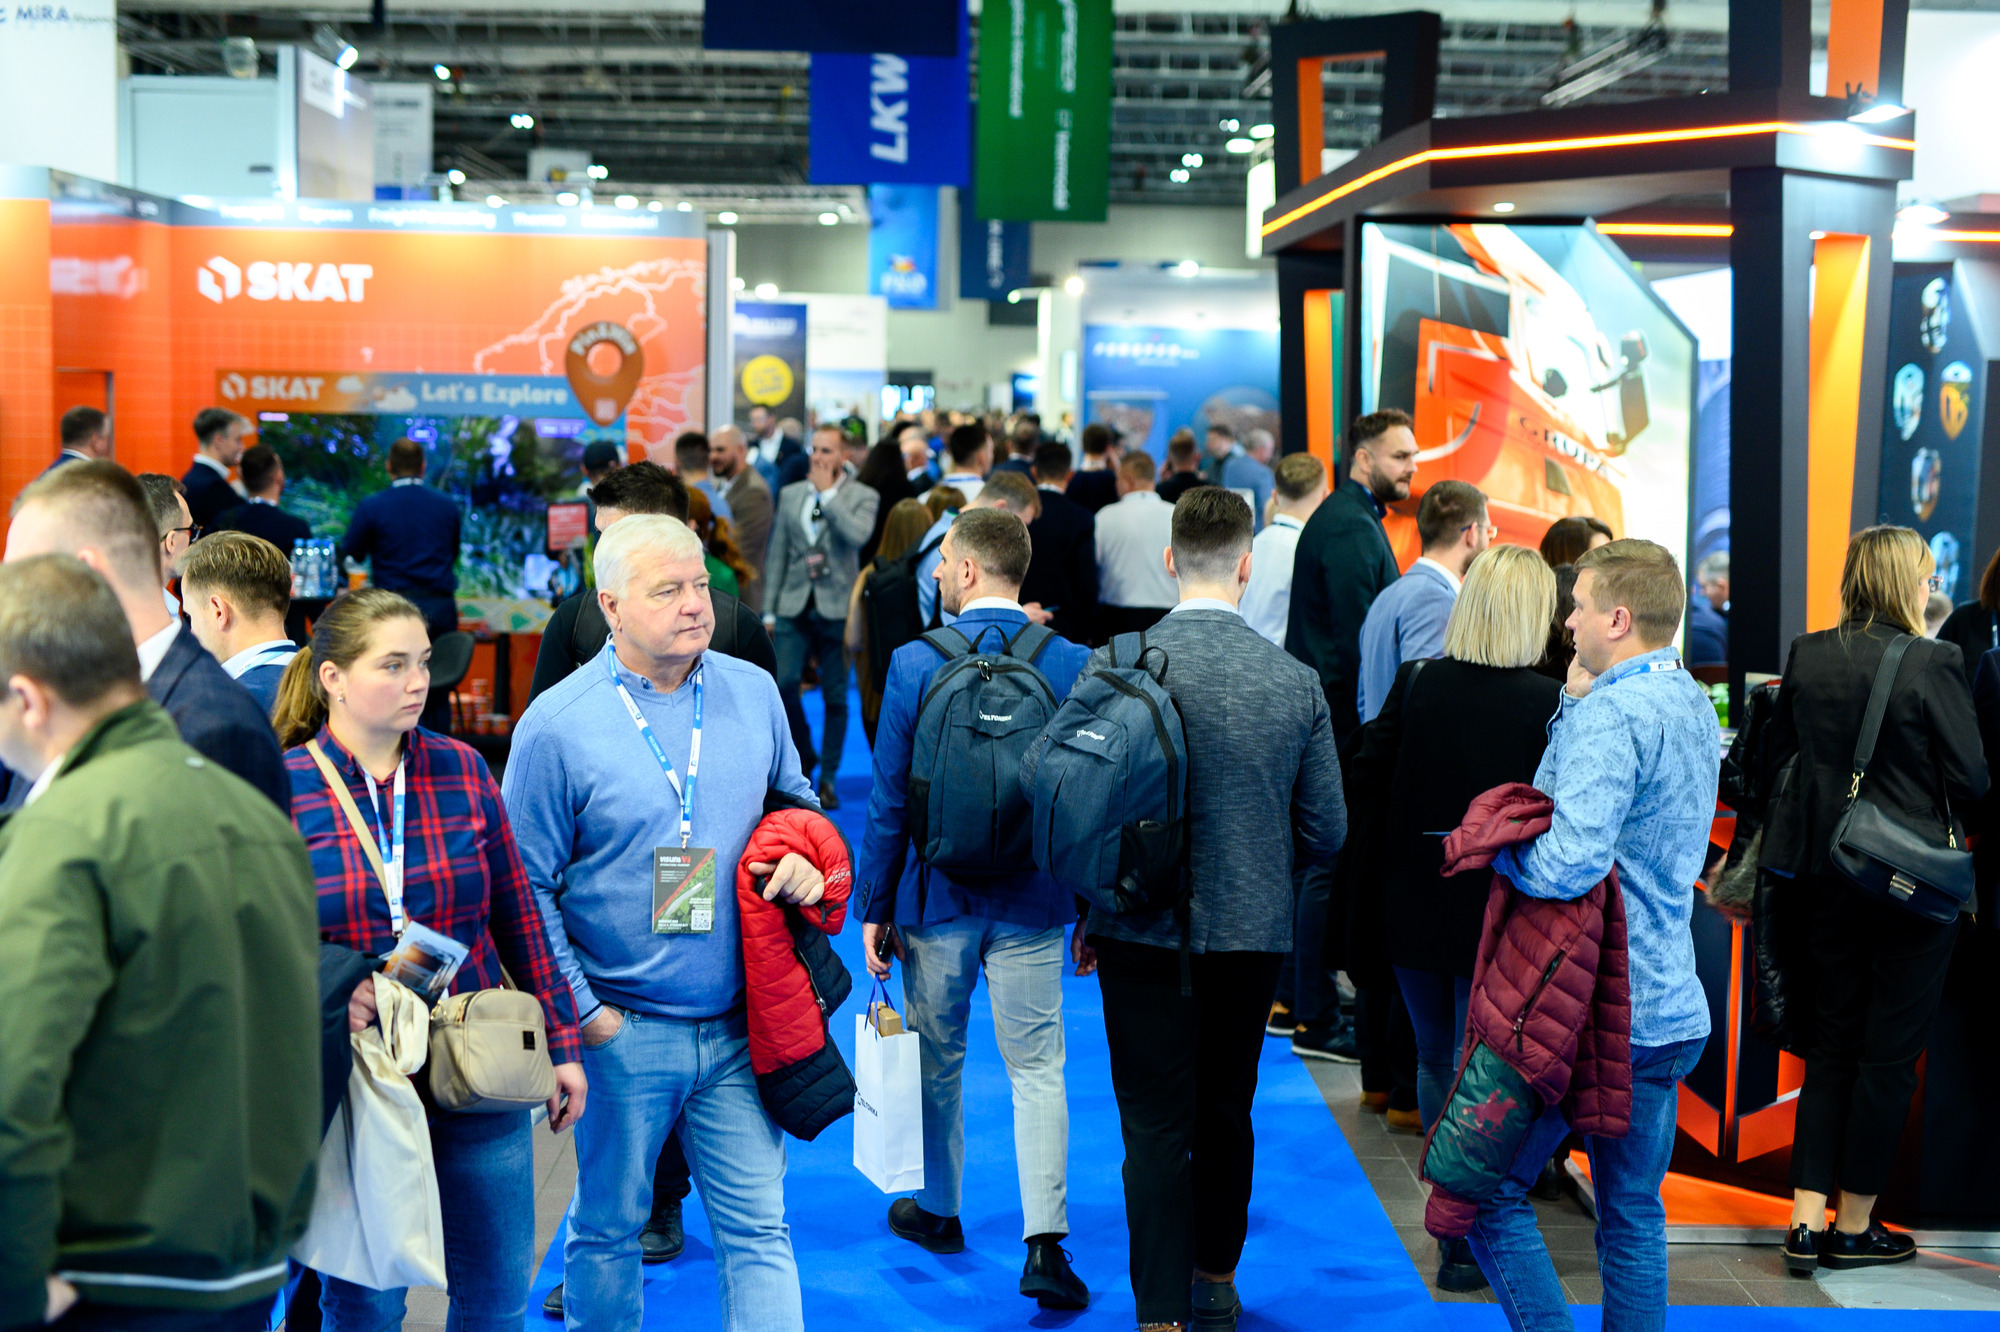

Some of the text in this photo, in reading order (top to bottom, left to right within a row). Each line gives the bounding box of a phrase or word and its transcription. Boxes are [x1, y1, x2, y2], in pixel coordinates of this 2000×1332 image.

[869, 53, 909, 165] LKW
[246, 260, 374, 303] SKAT
[251, 375, 325, 400] SKAT
[421, 380, 568, 408] Let's Explore
